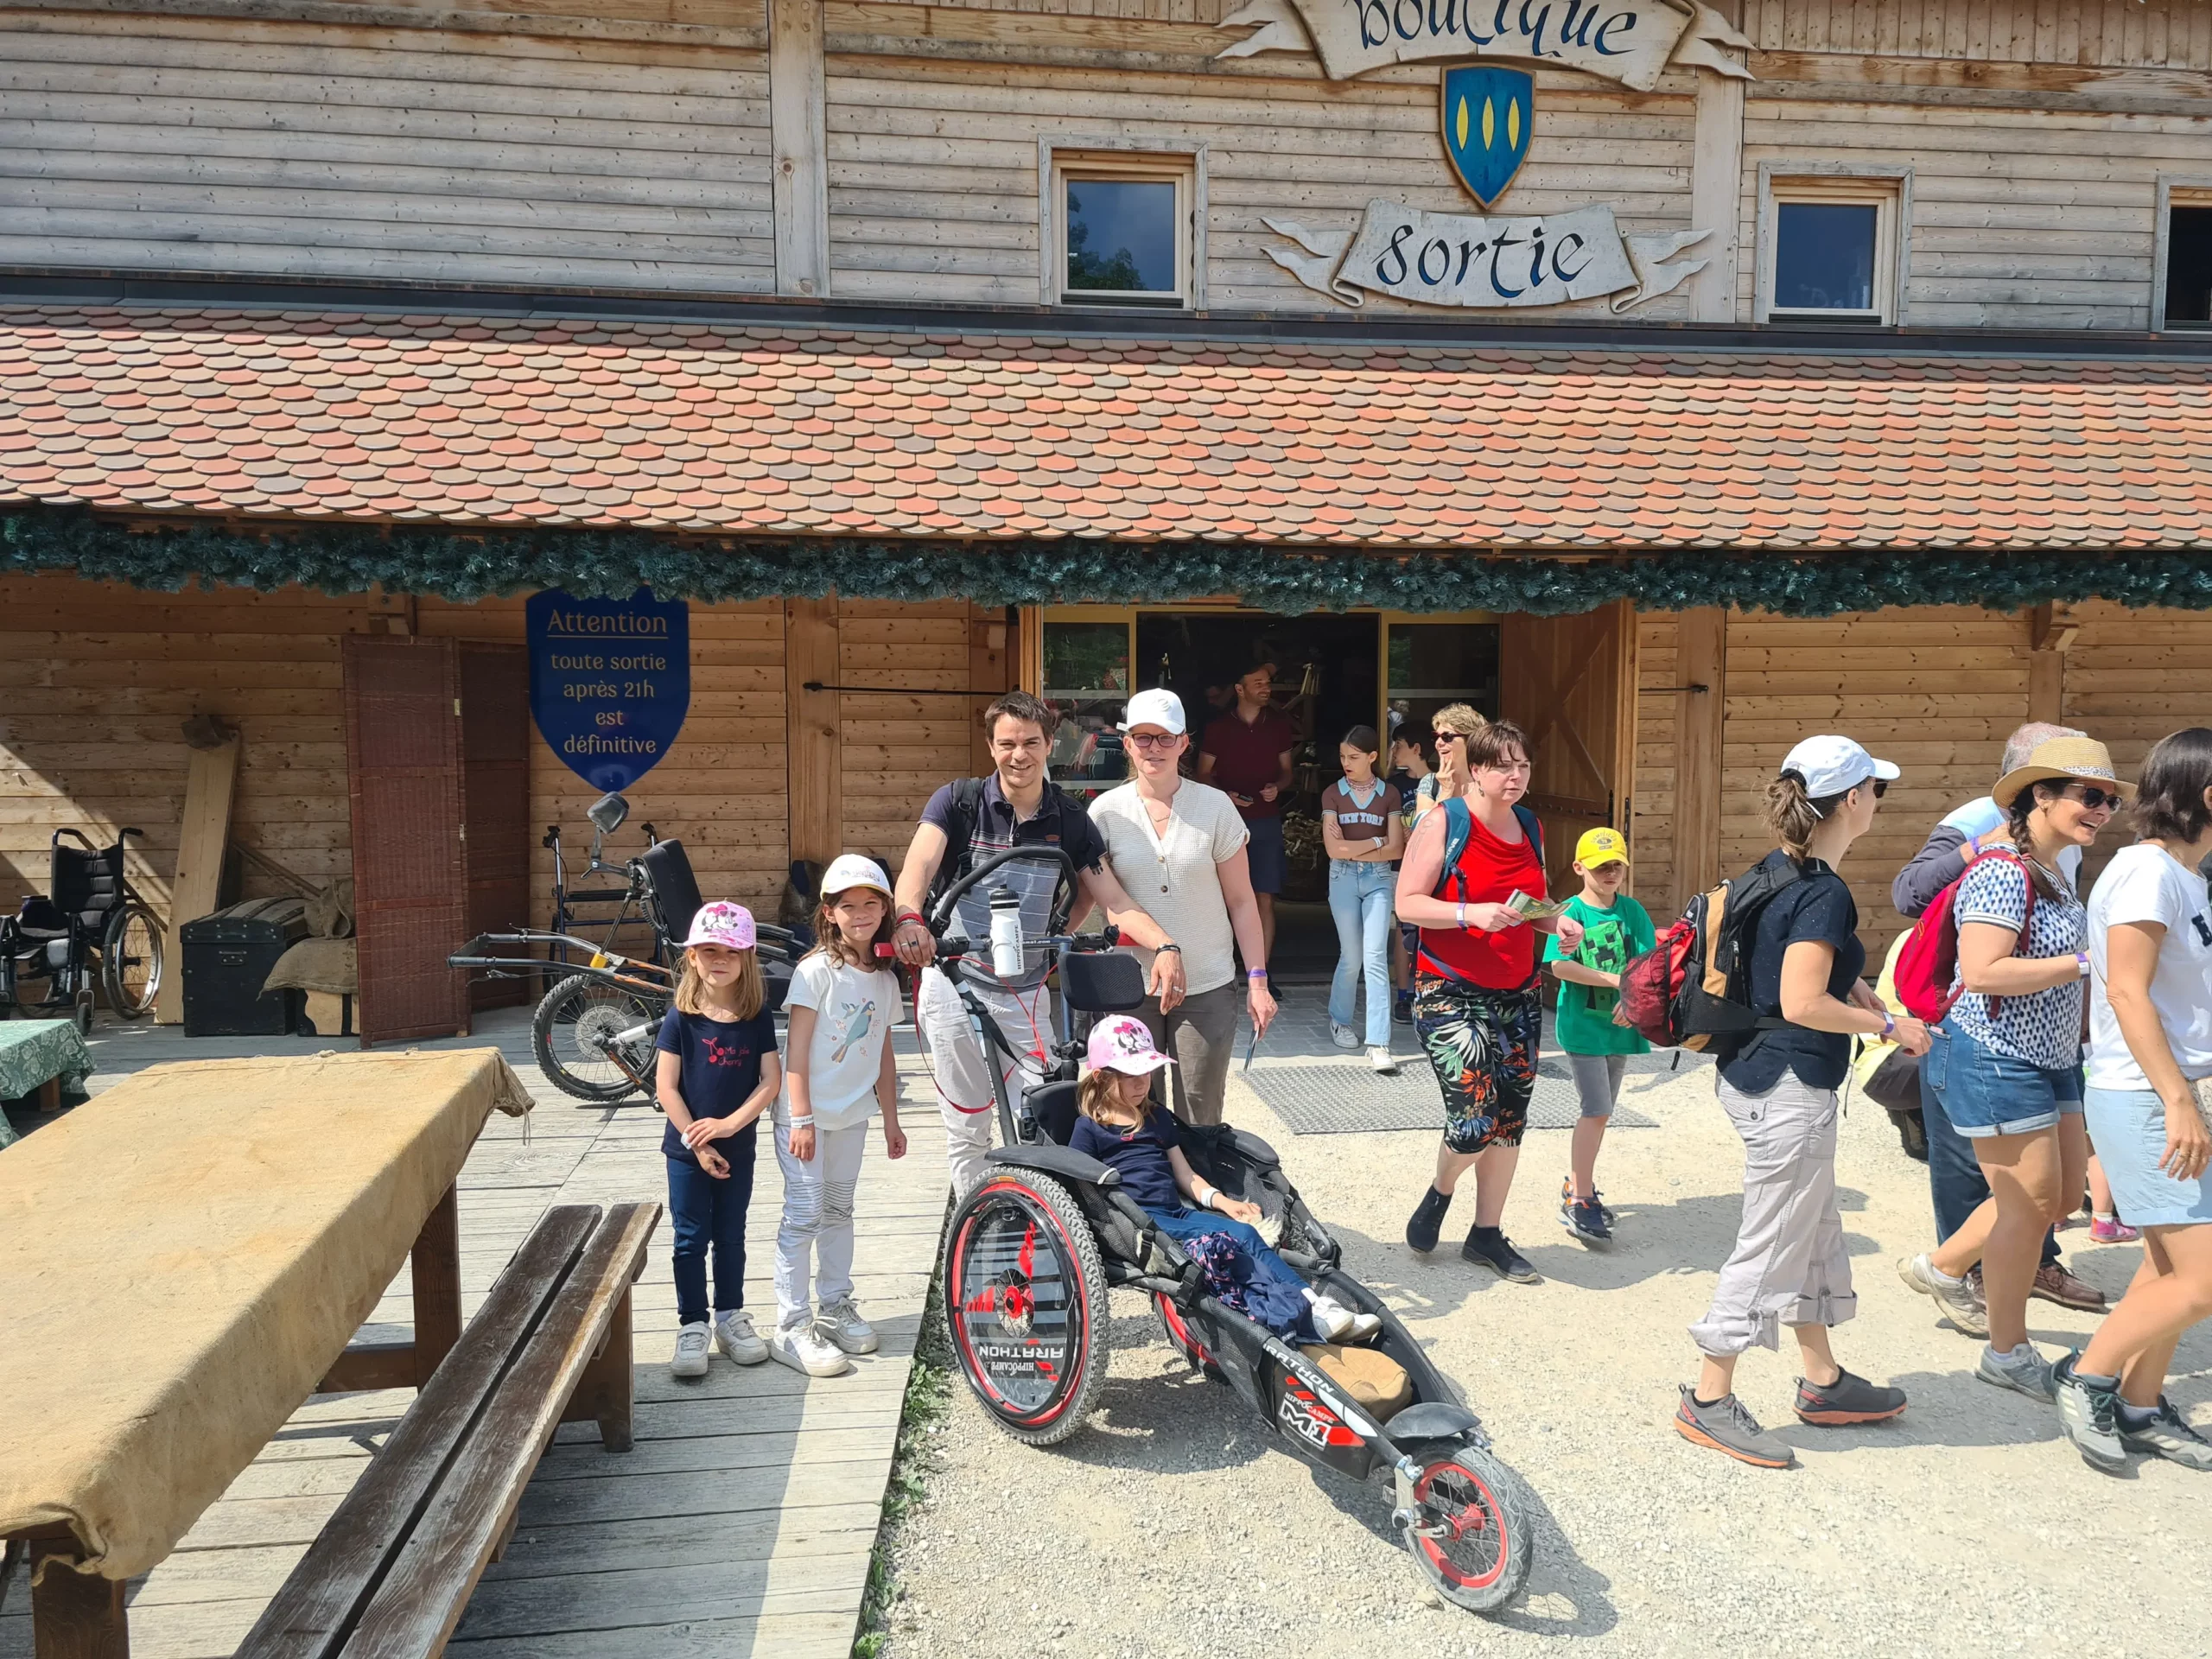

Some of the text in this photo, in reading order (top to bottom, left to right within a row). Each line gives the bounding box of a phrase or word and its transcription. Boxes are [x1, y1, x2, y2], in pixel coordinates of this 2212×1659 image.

[547, 609, 668, 632] Attention
[551, 654, 666, 671] toute sortie
[563, 680, 655, 702] après 21h
[595, 711, 624, 726] est
[564, 734, 657, 754] définitive
[1359, 812, 1384, 826] YORK
[1014, 925, 1022, 969] HIPPOCAMPE
[979, 1345, 1064, 1358] ARATHON
[990, 1361, 1034, 1372] HIPPOCAMPE
[1262, 1343, 1335, 1393] RATHON
[1284, 1391, 1334, 1424] HIPPOCAMPE
[1279, 1398, 1332, 1447] M1
